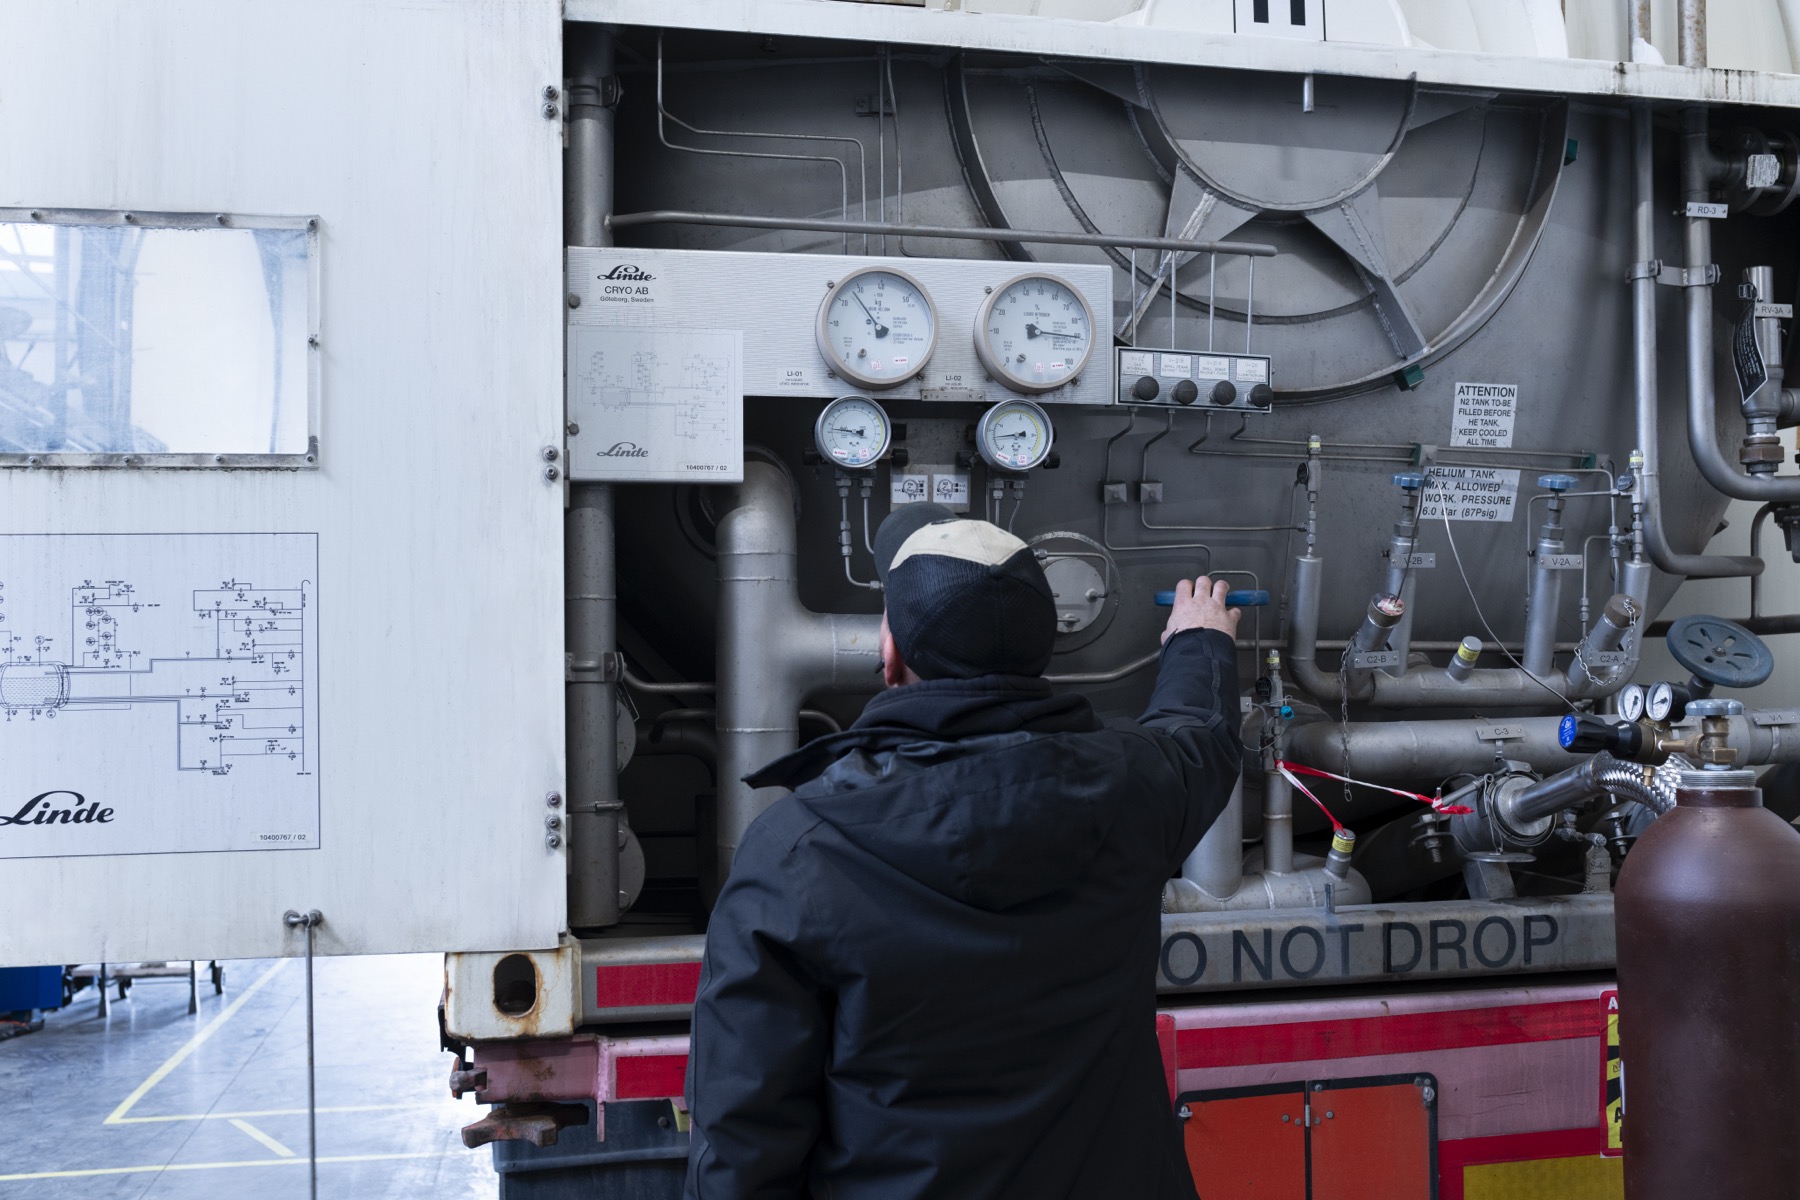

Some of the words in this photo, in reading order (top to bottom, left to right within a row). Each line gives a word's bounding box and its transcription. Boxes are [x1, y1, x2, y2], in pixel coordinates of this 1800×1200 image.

[1697, 206, 1717, 214] RD-3
[597, 264, 656, 281] Linde
[605, 286, 632, 294] CRYO
[635, 287, 649, 295] AB
[1761, 306, 1784, 314] RV-3A
[993, 327, 999, 335] 10
[1457, 385, 1515, 398] ATTENTION
[1460, 398, 1470, 406] N2
[1472, 398, 1490, 406] TANK
[1491, 399, 1501, 407] TO
[1502, 399, 1512, 407] BE
[1458, 408, 1482, 416] FILLED
[1483, 409, 1512, 417] BEFORE
[1468, 418, 1478, 426] HE
[1458, 428, 1478, 436] KEEP
[1478, 429, 1508, 437] COOLED
[1466, 438, 1479, 446] ALL
[1481, 438, 1497, 446] TIME
[596, 441, 649, 457] Linde
[1428, 467, 1466, 478] HELIUM
[1470, 469, 1496, 479] TANK
[1454, 482, 1501, 492] ALLOWED
[1424, 494, 1457, 504] WORK.
[1461, 495, 1512, 505] PRESSURE
[1422, 506, 1437, 516] 6.0
[1461, 508, 1498, 519] (87Psig)
[1404, 557, 1423, 565] V-2B
[1551, 557, 1571, 566] V-2A
[1366, 655, 1387, 664] C2-B
[1600, 655, 1620, 663] C2-A
[1494, 727, 1509, 735] C-3
[0, 790, 115, 826] Linde
[1232, 923, 1364, 983] NOT
[1383, 914, 1560, 974] DROP
